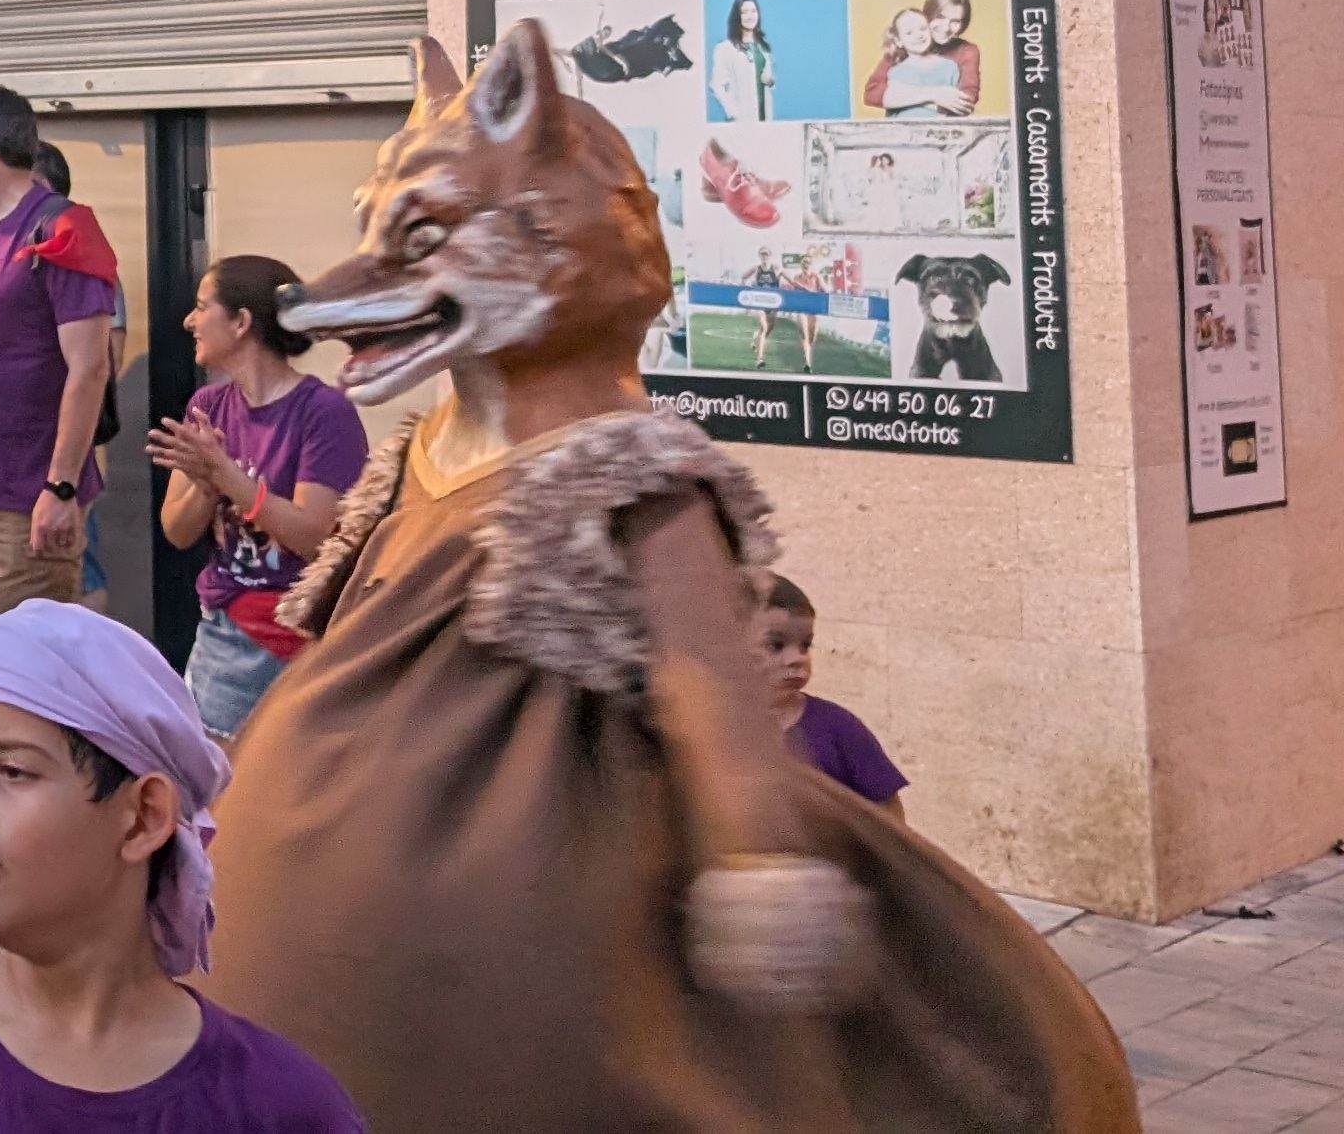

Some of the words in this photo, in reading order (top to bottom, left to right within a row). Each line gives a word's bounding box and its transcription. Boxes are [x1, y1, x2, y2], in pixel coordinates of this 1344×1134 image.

[1016, 8, 1050, 83] Esports
[1026, 108, 1055, 227] Casaments
[1032, 250, 1061, 350] Producte
[649, 390, 788, 420] tos@gmail.com
[853, 389, 889, 413] 649
[898, 391, 925, 414] 50
[935, 393, 961, 415] 06
[969, 395, 995, 418] 27
[853, 418, 959, 445] mesQfotos
